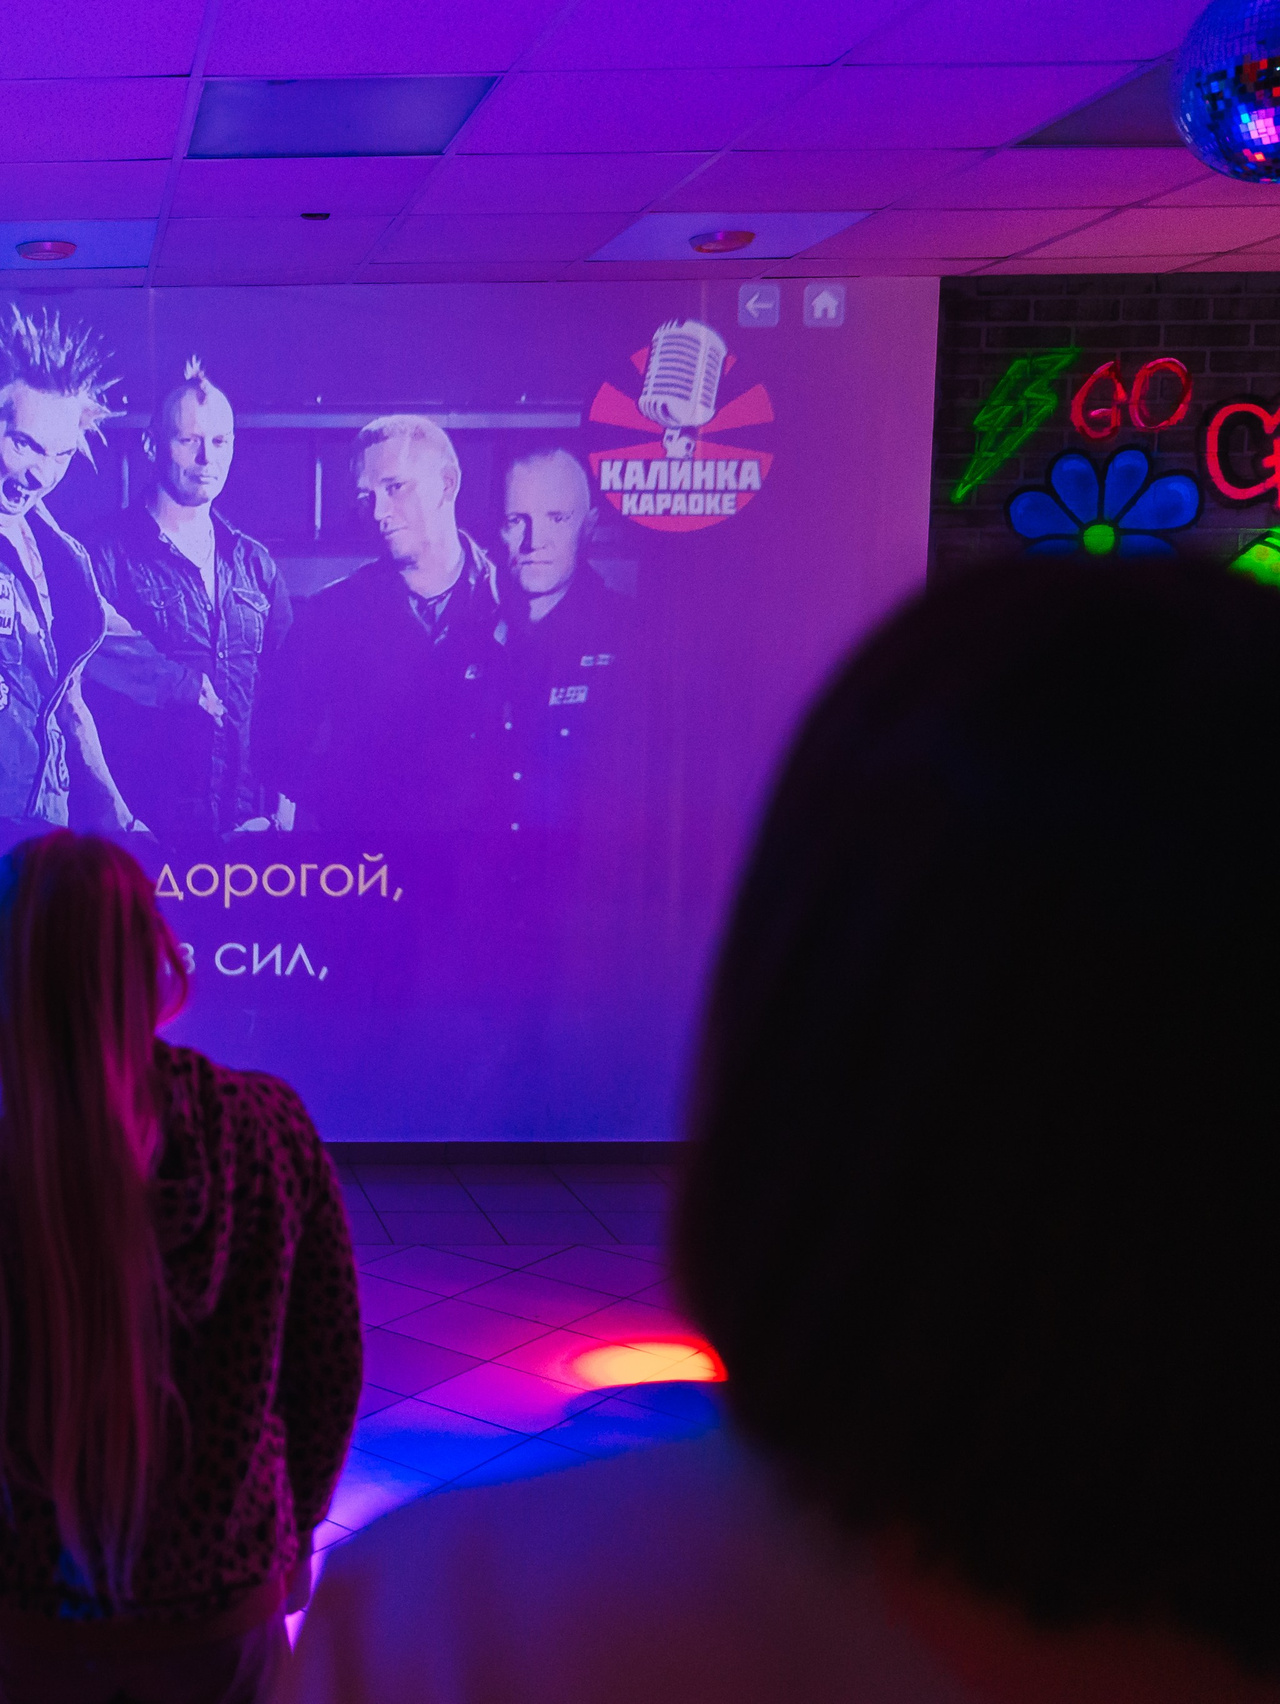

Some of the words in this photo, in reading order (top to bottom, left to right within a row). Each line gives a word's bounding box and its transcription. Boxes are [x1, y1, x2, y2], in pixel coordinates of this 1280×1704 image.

[1070, 356, 1193, 441] GO
[600, 459, 761, 491] КАЛИНКА
[622, 493, 736, 515] КАРАОКЕ
[154, 853, 403, 908] дорогой,
[214, 943, 328, 981] сил,
